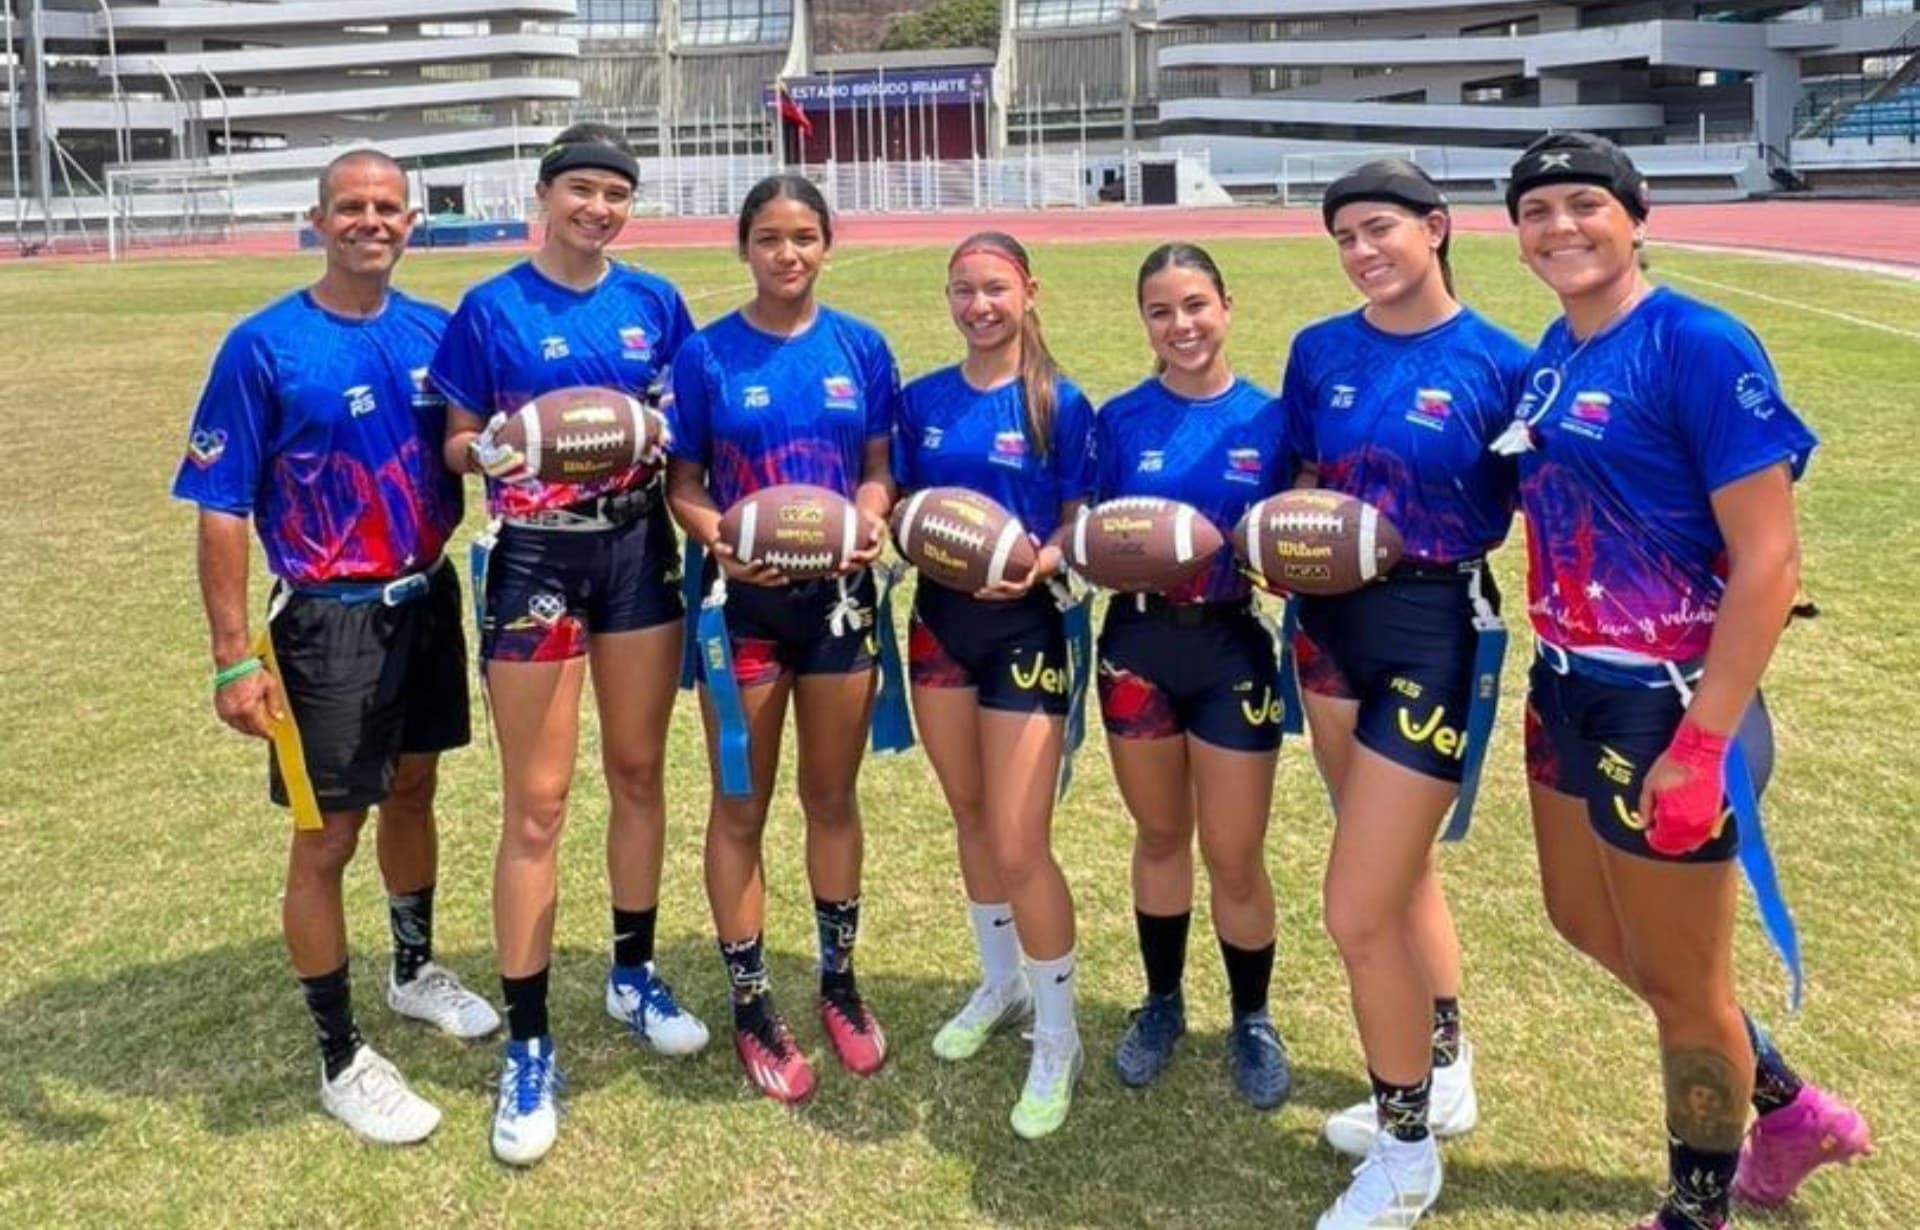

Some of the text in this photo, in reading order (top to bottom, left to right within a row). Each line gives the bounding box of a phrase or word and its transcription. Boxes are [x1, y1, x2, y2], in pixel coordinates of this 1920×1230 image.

[791, 85, 849, 99] ESTADIO
[912, 79, 966, 94] IRIARTE
[1277, 539, 1332, 558] Wilson
[1391, 677, 1422, 699] RS
